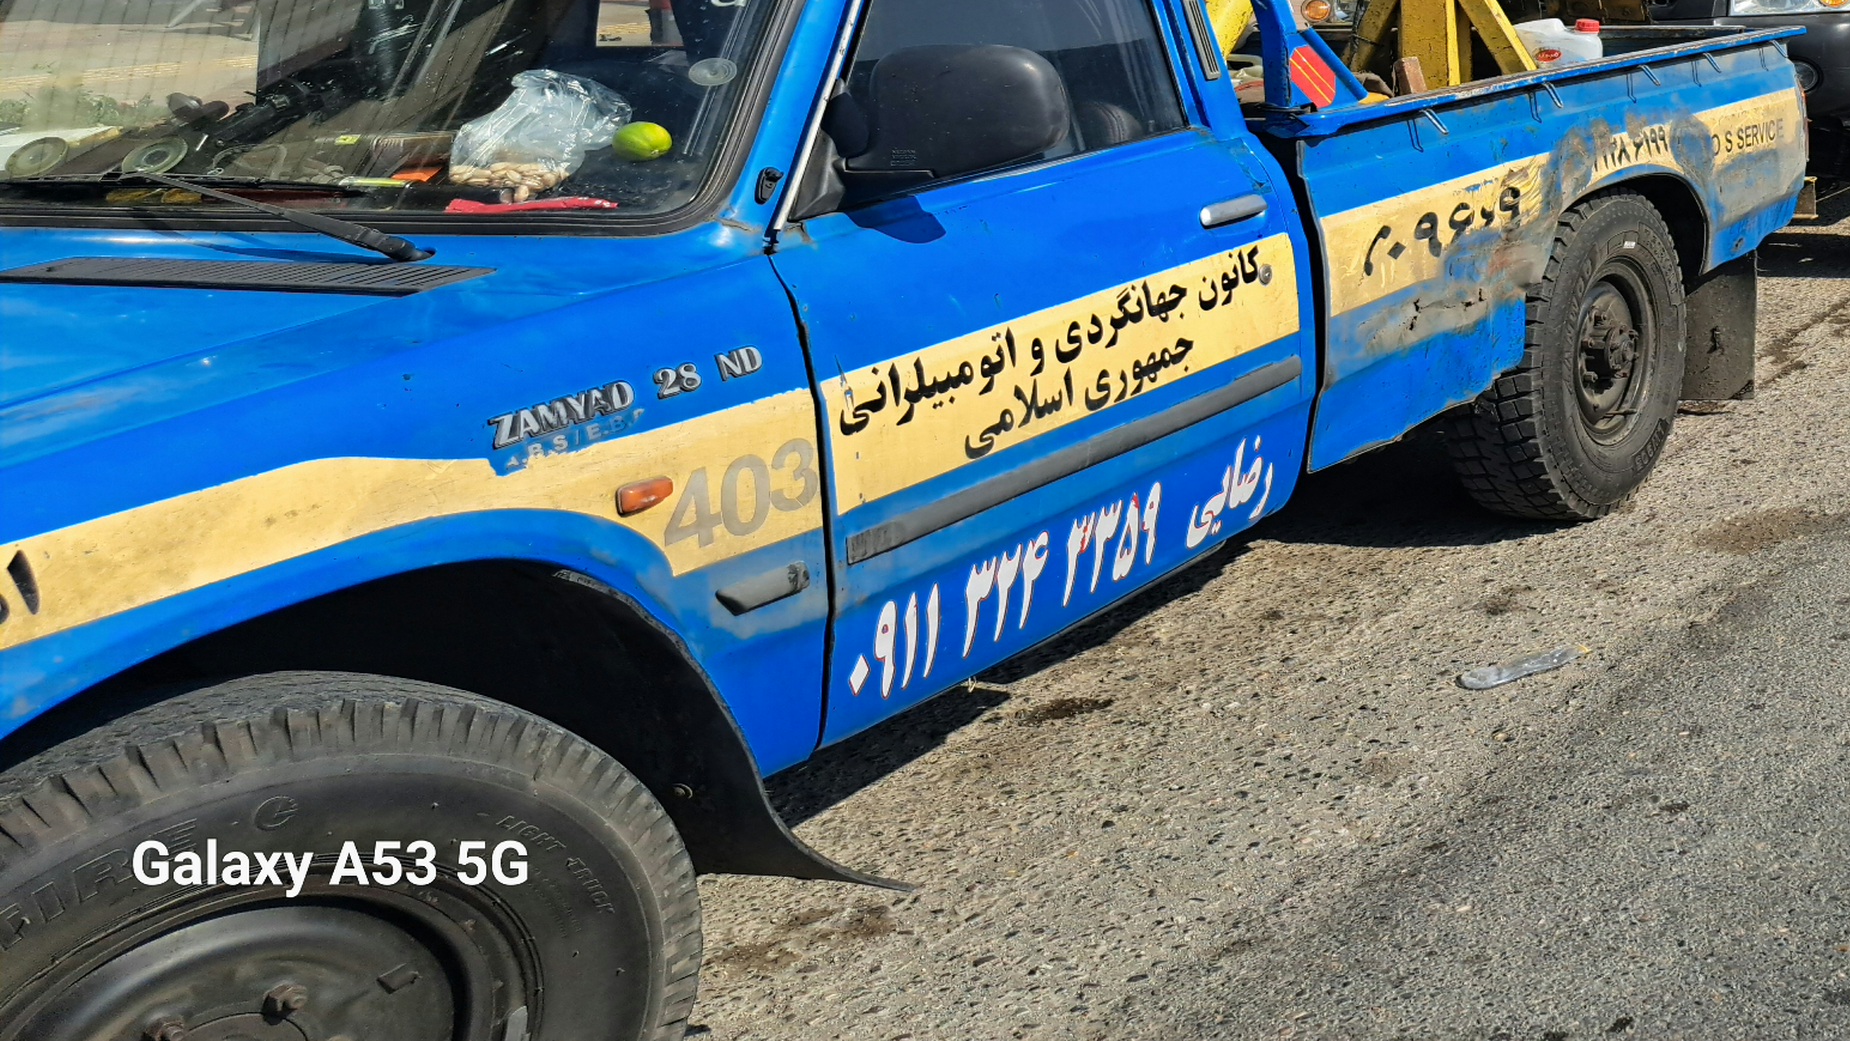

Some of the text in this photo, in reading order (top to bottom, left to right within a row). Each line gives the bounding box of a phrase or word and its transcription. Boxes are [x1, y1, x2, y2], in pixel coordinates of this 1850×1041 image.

[1737, 117, 1784, 148] SERVICE
[487, 345, 764, 450] ZAMYAD 28 ND
[839, 245, 1260, 436] کانون جهانگردی و اتومبیلرانی
[964, 334, 1195, 461] جمهوری اسلامی
[662, 437, 820, 549] 403
[1186, 434, 1275, 550] رضایی
[848, 582, 942, 700] ۰۹۱۱
